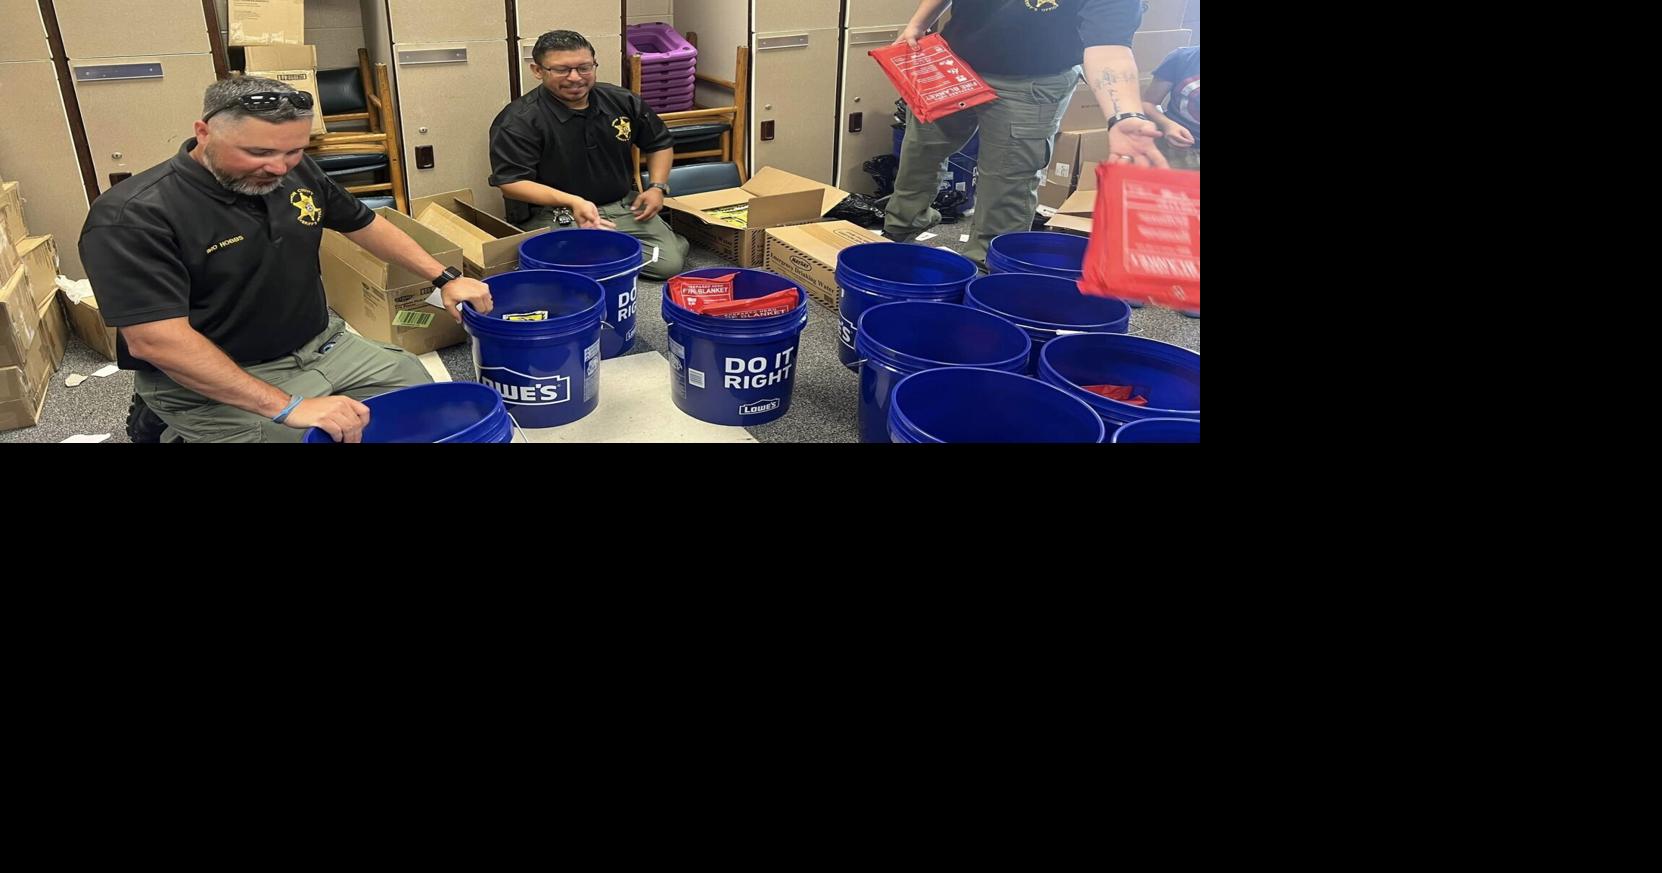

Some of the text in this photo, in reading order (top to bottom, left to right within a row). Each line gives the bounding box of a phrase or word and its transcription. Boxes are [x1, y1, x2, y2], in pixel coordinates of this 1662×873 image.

[698, 286, 729, 295] BLANKET
[817, 280, 834, 294] Water
[725, 346, 794, 374] DO IT
[724, 363, 792, 389] RIGHT
[744, 401, 777, 413] LOWE'S
